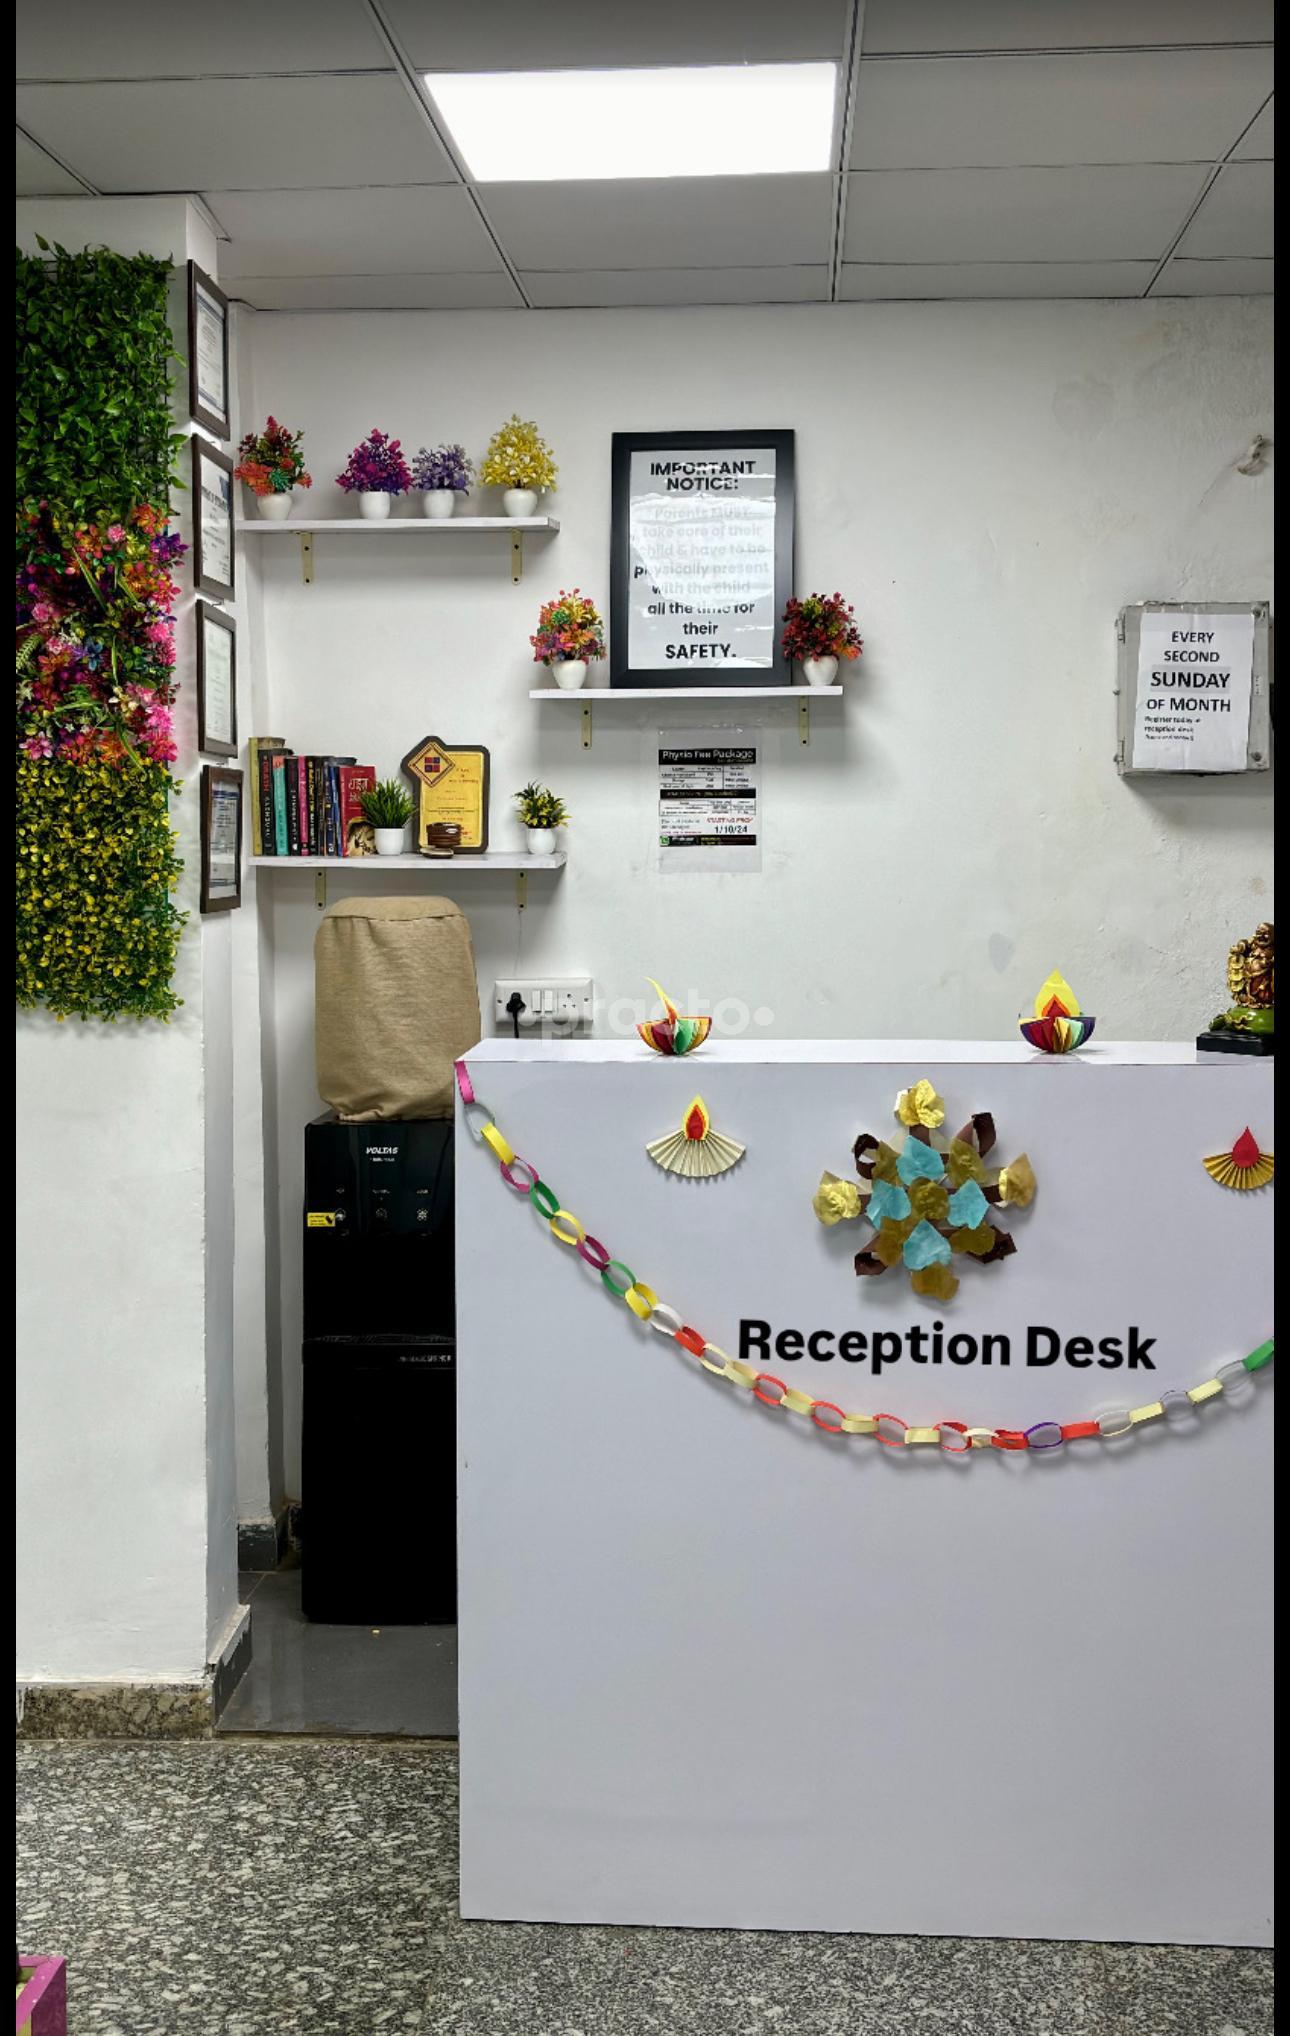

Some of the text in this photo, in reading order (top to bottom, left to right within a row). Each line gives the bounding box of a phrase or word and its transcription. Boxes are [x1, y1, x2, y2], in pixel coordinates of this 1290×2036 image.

[650, 460, 756, 476] IMPORTANT
[647, 601, 666, 615] all
[669, 601, 693, 614] the
[683, 621, 719, 635] their
[1171, 631, 1215, 643] EVERY
[665, 643, 737, 660] SAFETY.
[1164, 650, 1220, 663] SECOND
[1150, 671, 1231, 688] SUNDAY
[1146, 698, 1231, 712] OF MONTH
[366, 1146, 398, 1155] VOLTAS
[738, 1318, 1157, 1376] Reception Desk
